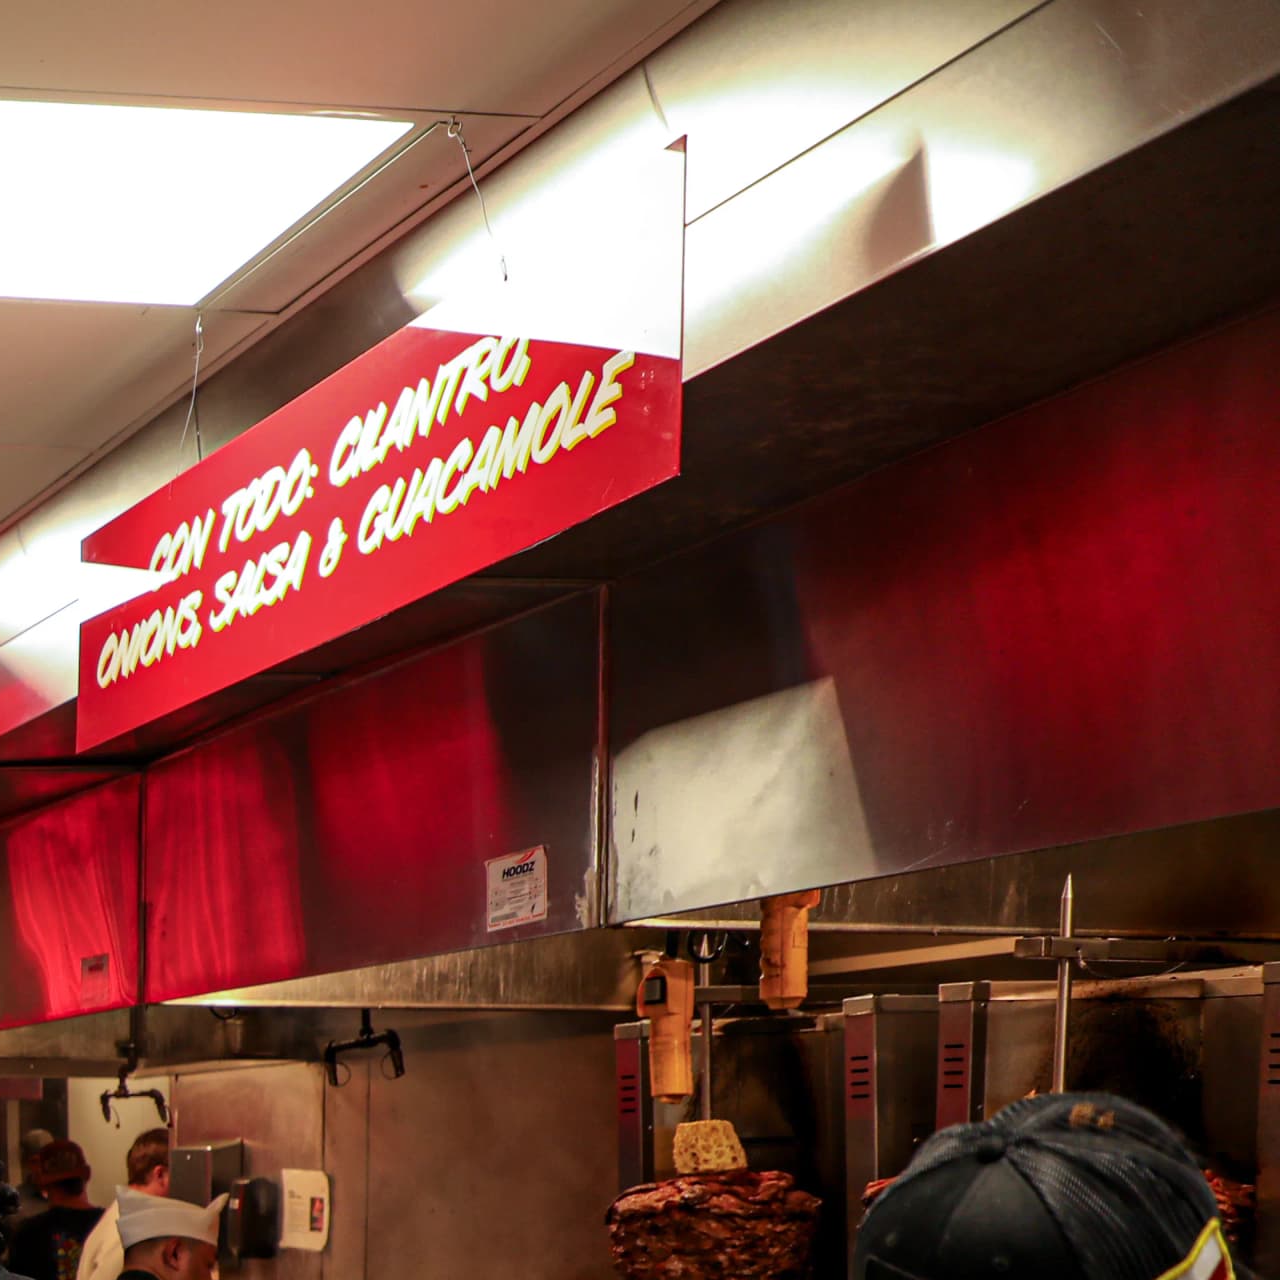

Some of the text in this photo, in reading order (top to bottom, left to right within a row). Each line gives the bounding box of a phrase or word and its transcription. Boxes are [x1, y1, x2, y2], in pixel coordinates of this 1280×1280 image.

[96, 349, 635, 688] ONIONS, SALSA & GUACAMOLE
[148, 336, 532, 592] CON TODO: CILANTRO,
[502, 860, 536, 880] HOODZ
